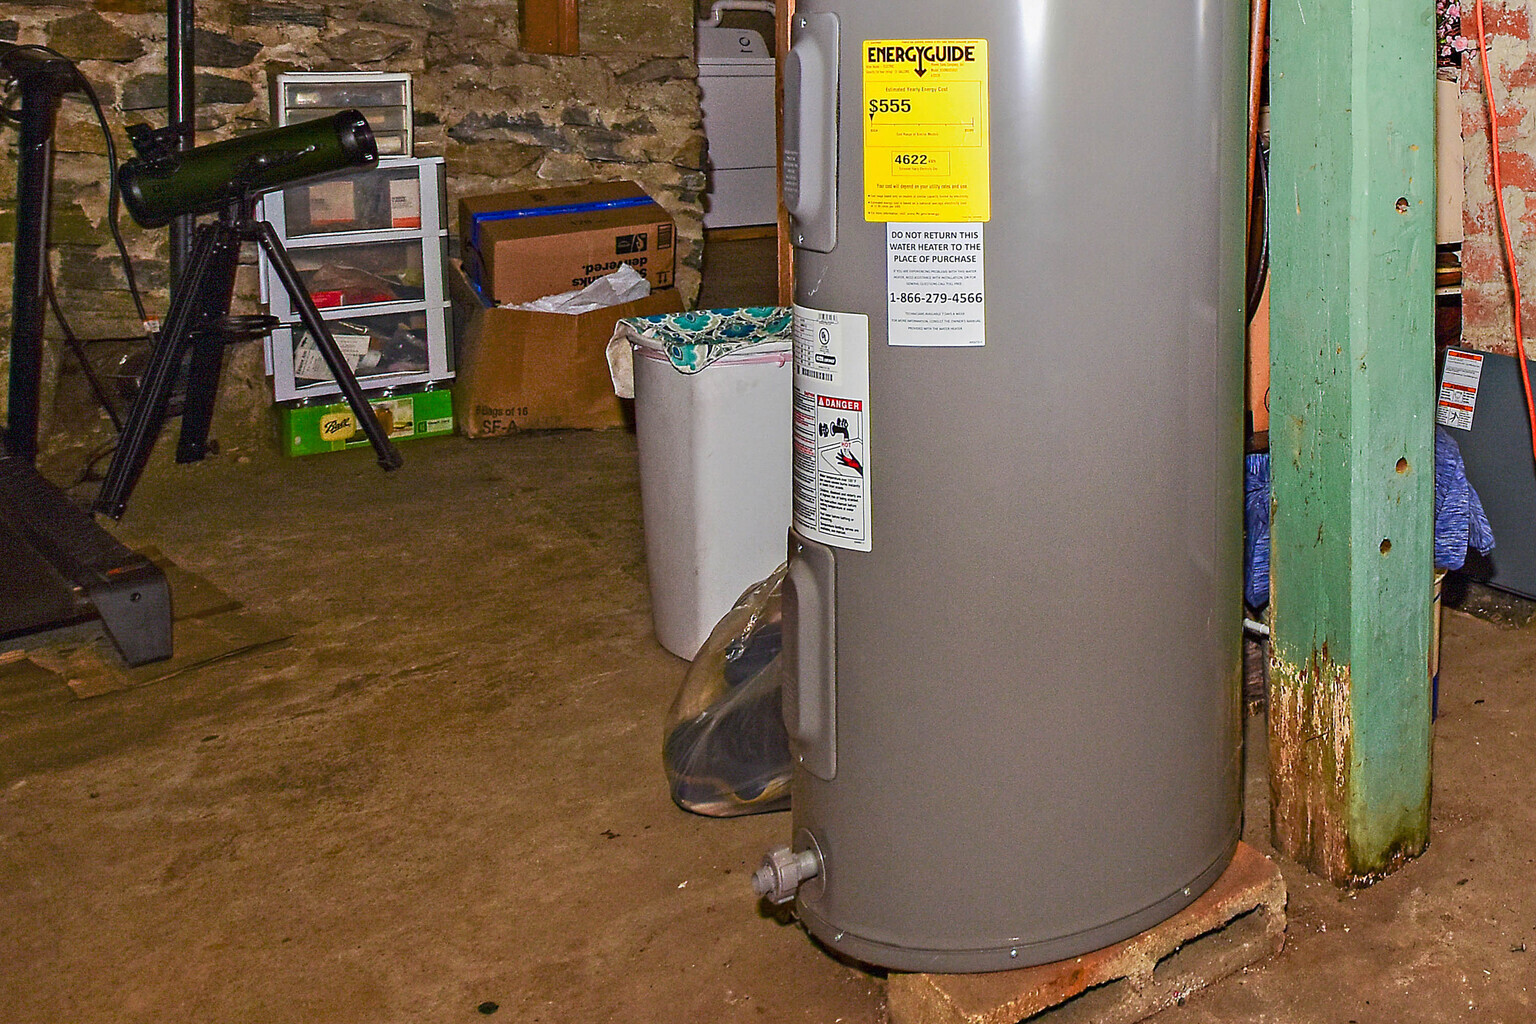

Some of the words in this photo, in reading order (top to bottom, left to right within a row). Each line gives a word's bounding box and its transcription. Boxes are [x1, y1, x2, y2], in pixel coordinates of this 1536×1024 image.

[868, 46, 975, 64] ENERGYGUIDE
[869, 99, 911, 113] $555
[895, 155, 927, 164] 4622
[890, 293, 982, 303] 1-866-279-4566
[825, 400, 860, 410] DANGER
[517, 406, 528, 416] 16
[324, 417, 350, 434] Ball
